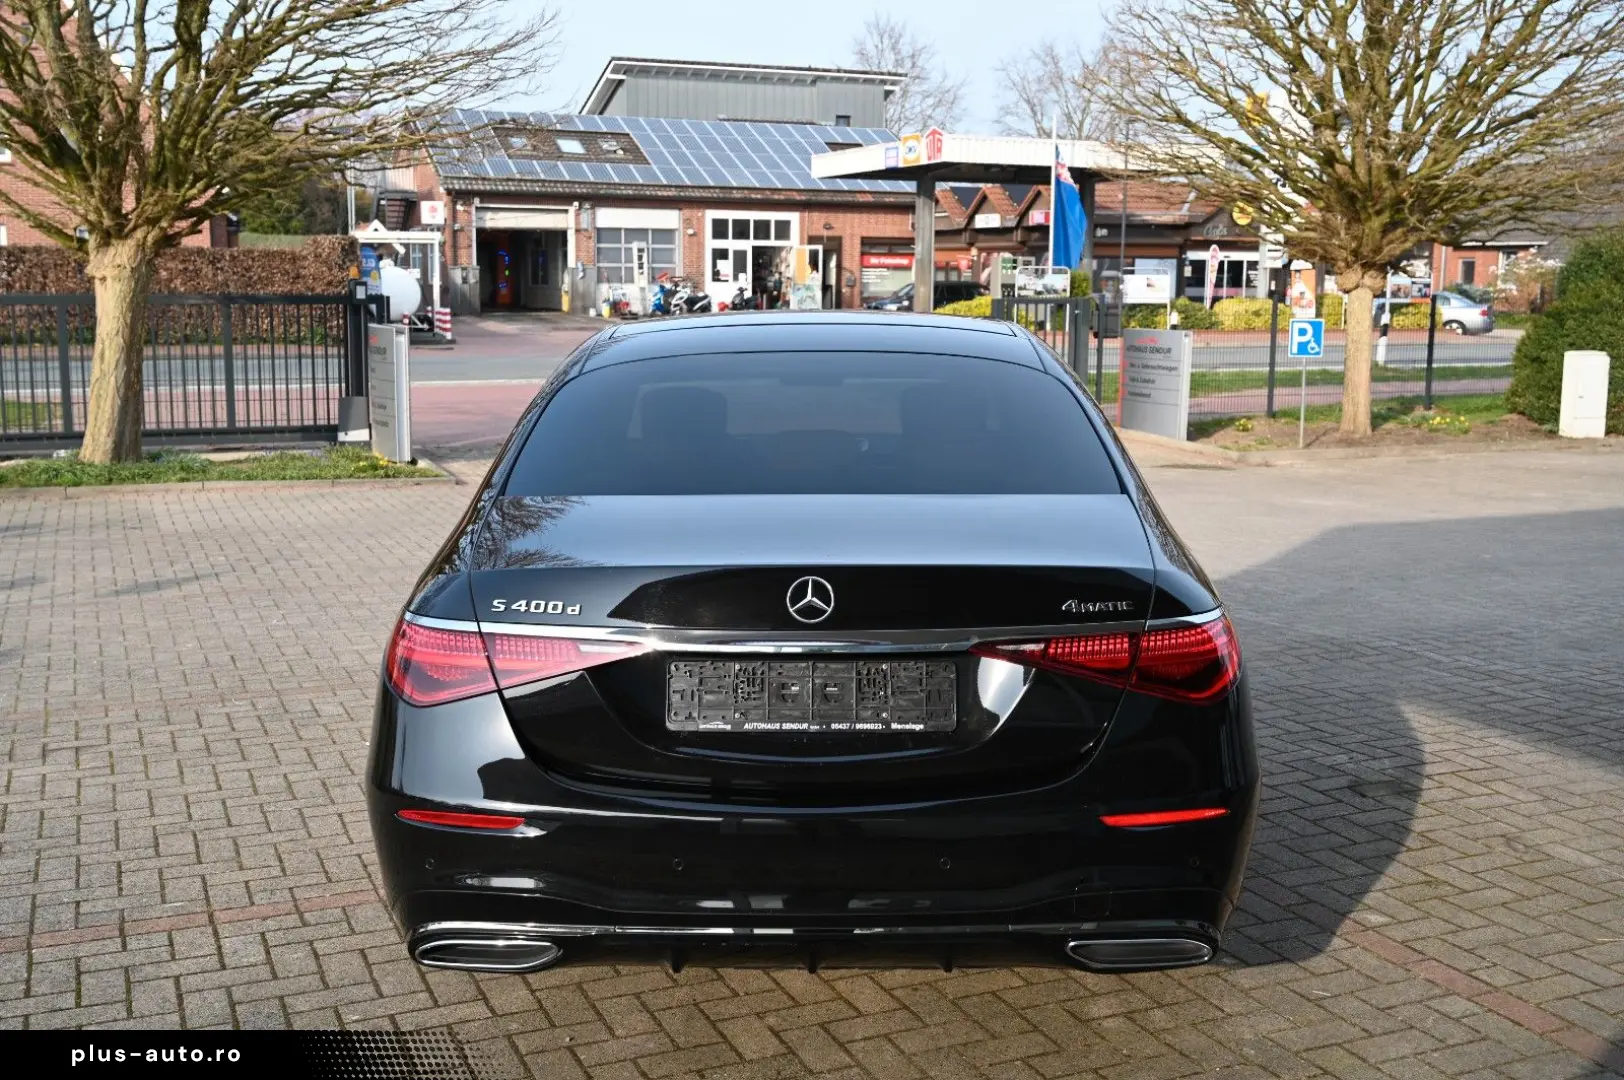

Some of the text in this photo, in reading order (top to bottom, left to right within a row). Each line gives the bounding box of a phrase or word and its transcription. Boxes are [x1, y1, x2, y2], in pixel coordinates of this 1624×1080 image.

[1292, 323, 1313, 354] P
[1149, 346, 1172, 355] SENDUR
[491, 599, 506, 612] S
[1061, 599, 1134, 613] 4MATIC
[743, 722, 780, 730] AUTOHAUS
[781, 722, 808, 730] SENDUR
